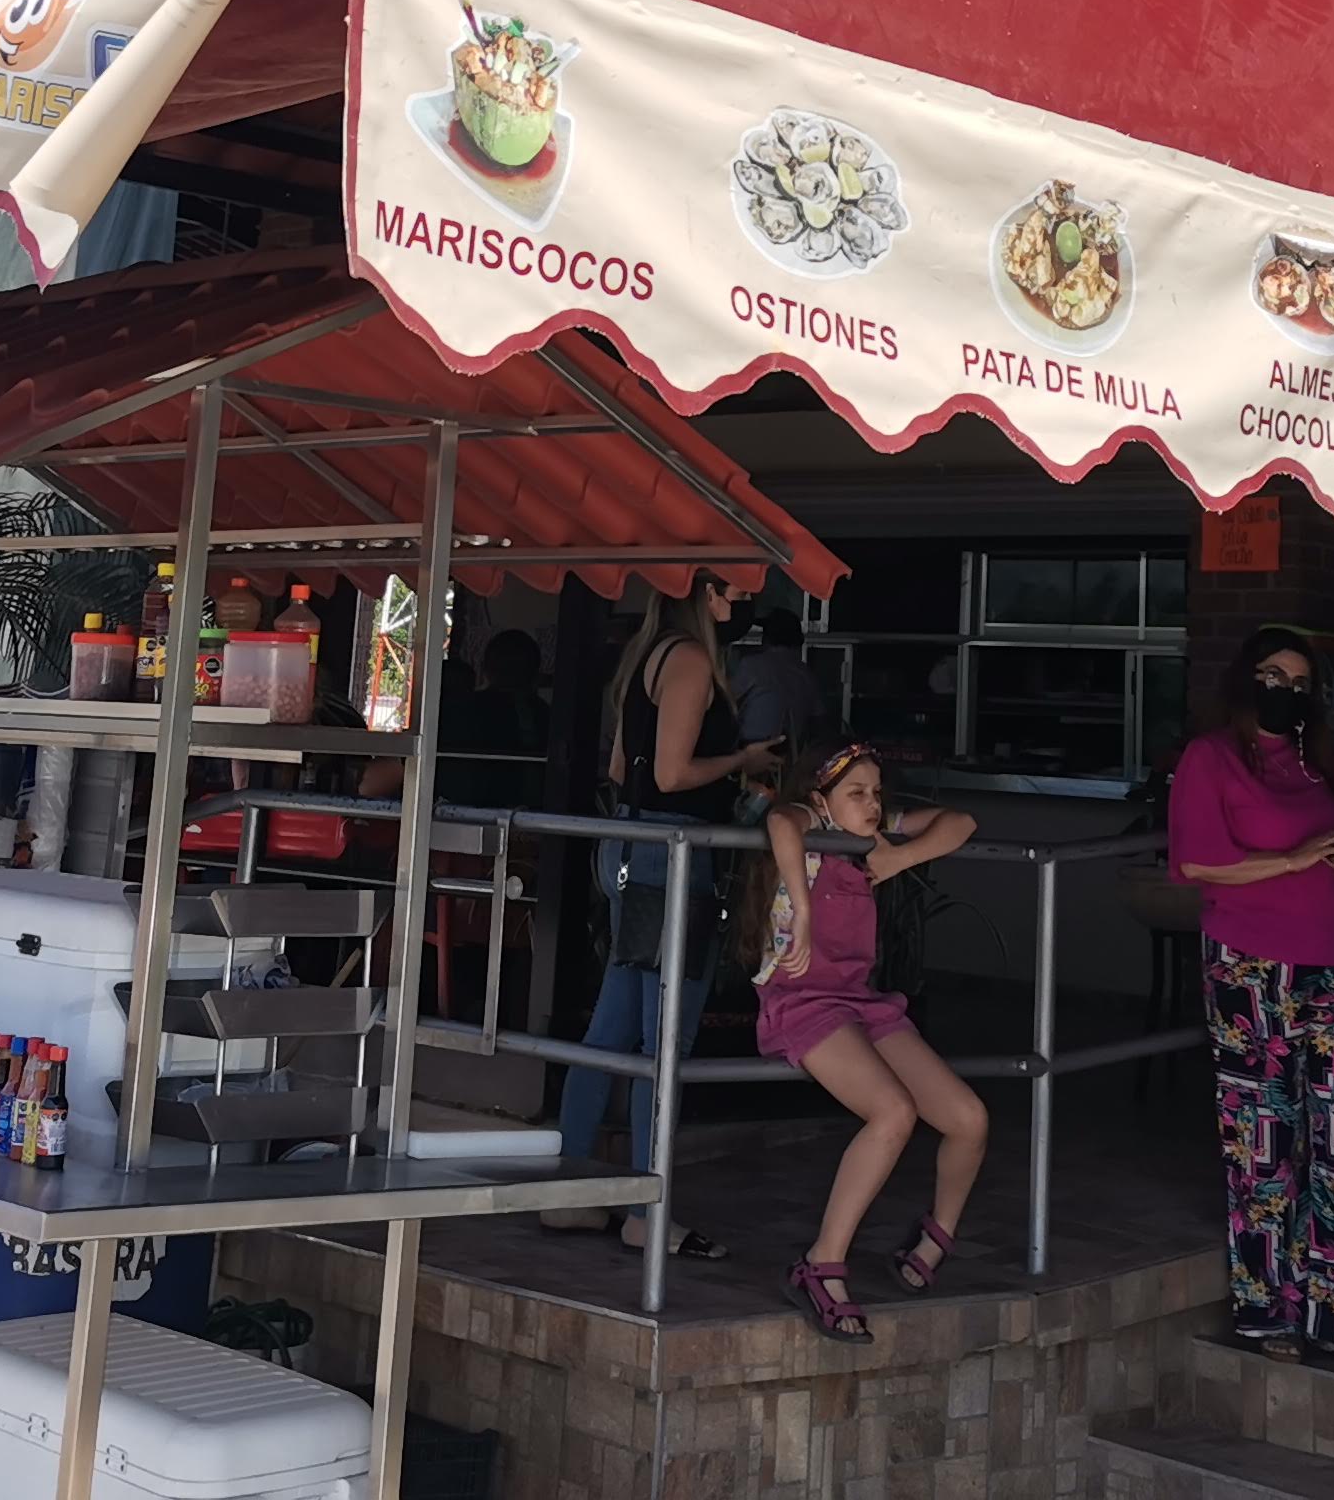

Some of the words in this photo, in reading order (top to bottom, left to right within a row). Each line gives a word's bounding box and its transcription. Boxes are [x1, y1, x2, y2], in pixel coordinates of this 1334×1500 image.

[375, 199, 655, 301] MARISCOCOS
[730, 285, 899, 361] OSTIONES
[962, 343, 1037, 389] PATA
[1044, 359, 1085, 399] DE
[1094, 370, 1183, 421] MULA
[9, 1235, 158, 1282] BASRA
